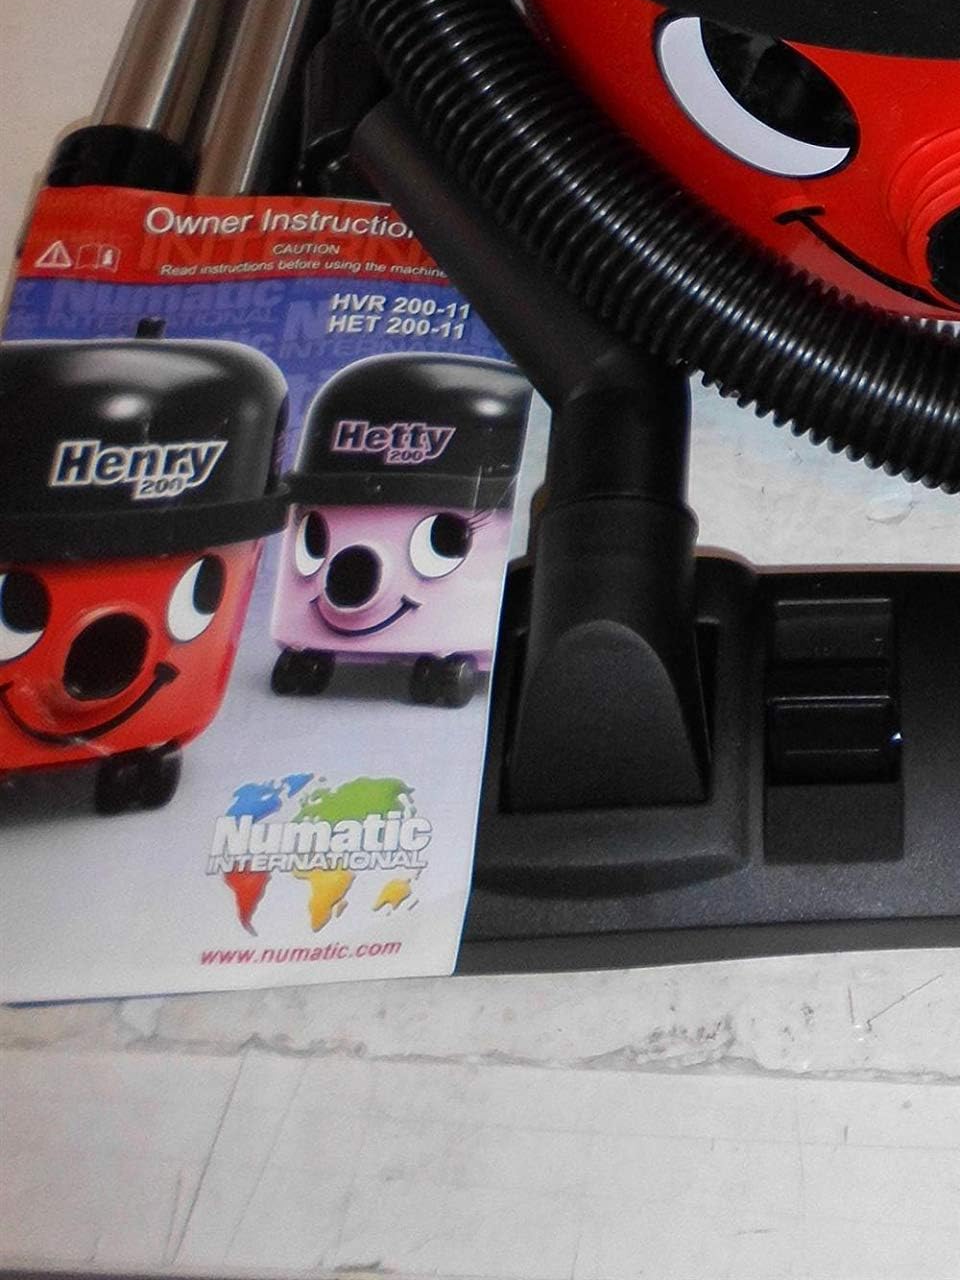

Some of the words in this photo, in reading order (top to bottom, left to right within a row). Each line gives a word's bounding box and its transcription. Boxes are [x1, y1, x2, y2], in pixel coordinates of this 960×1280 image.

[146, 206, 254, 234] Owner
[261, 208, 415, 239] Instructio
[272, 243, 340, 255] CAUTION
[160, 263, 196, 276] Read
[200, 259, 273, 275] instructions
[278, 258, 321, 270] before
[324, 260, 361, 273] using
[365, 261, 387, 273] the
[332, 293, 386, 312] HVR
[393, 296, 471, 320] 200-11
[328, 315, 381, 333] HET
[386, 317, 465, 339] 200-11
[332, 421, 456, 459] Hetty
[50, 440, 228, 488] Henry
[386, 448, 426, 464] 200
[210, 811, 432, 855] Numatic
[206, 850, 428, 875] INTERNATIONAL
[200, 941, 402, 966] www.numatic.com
